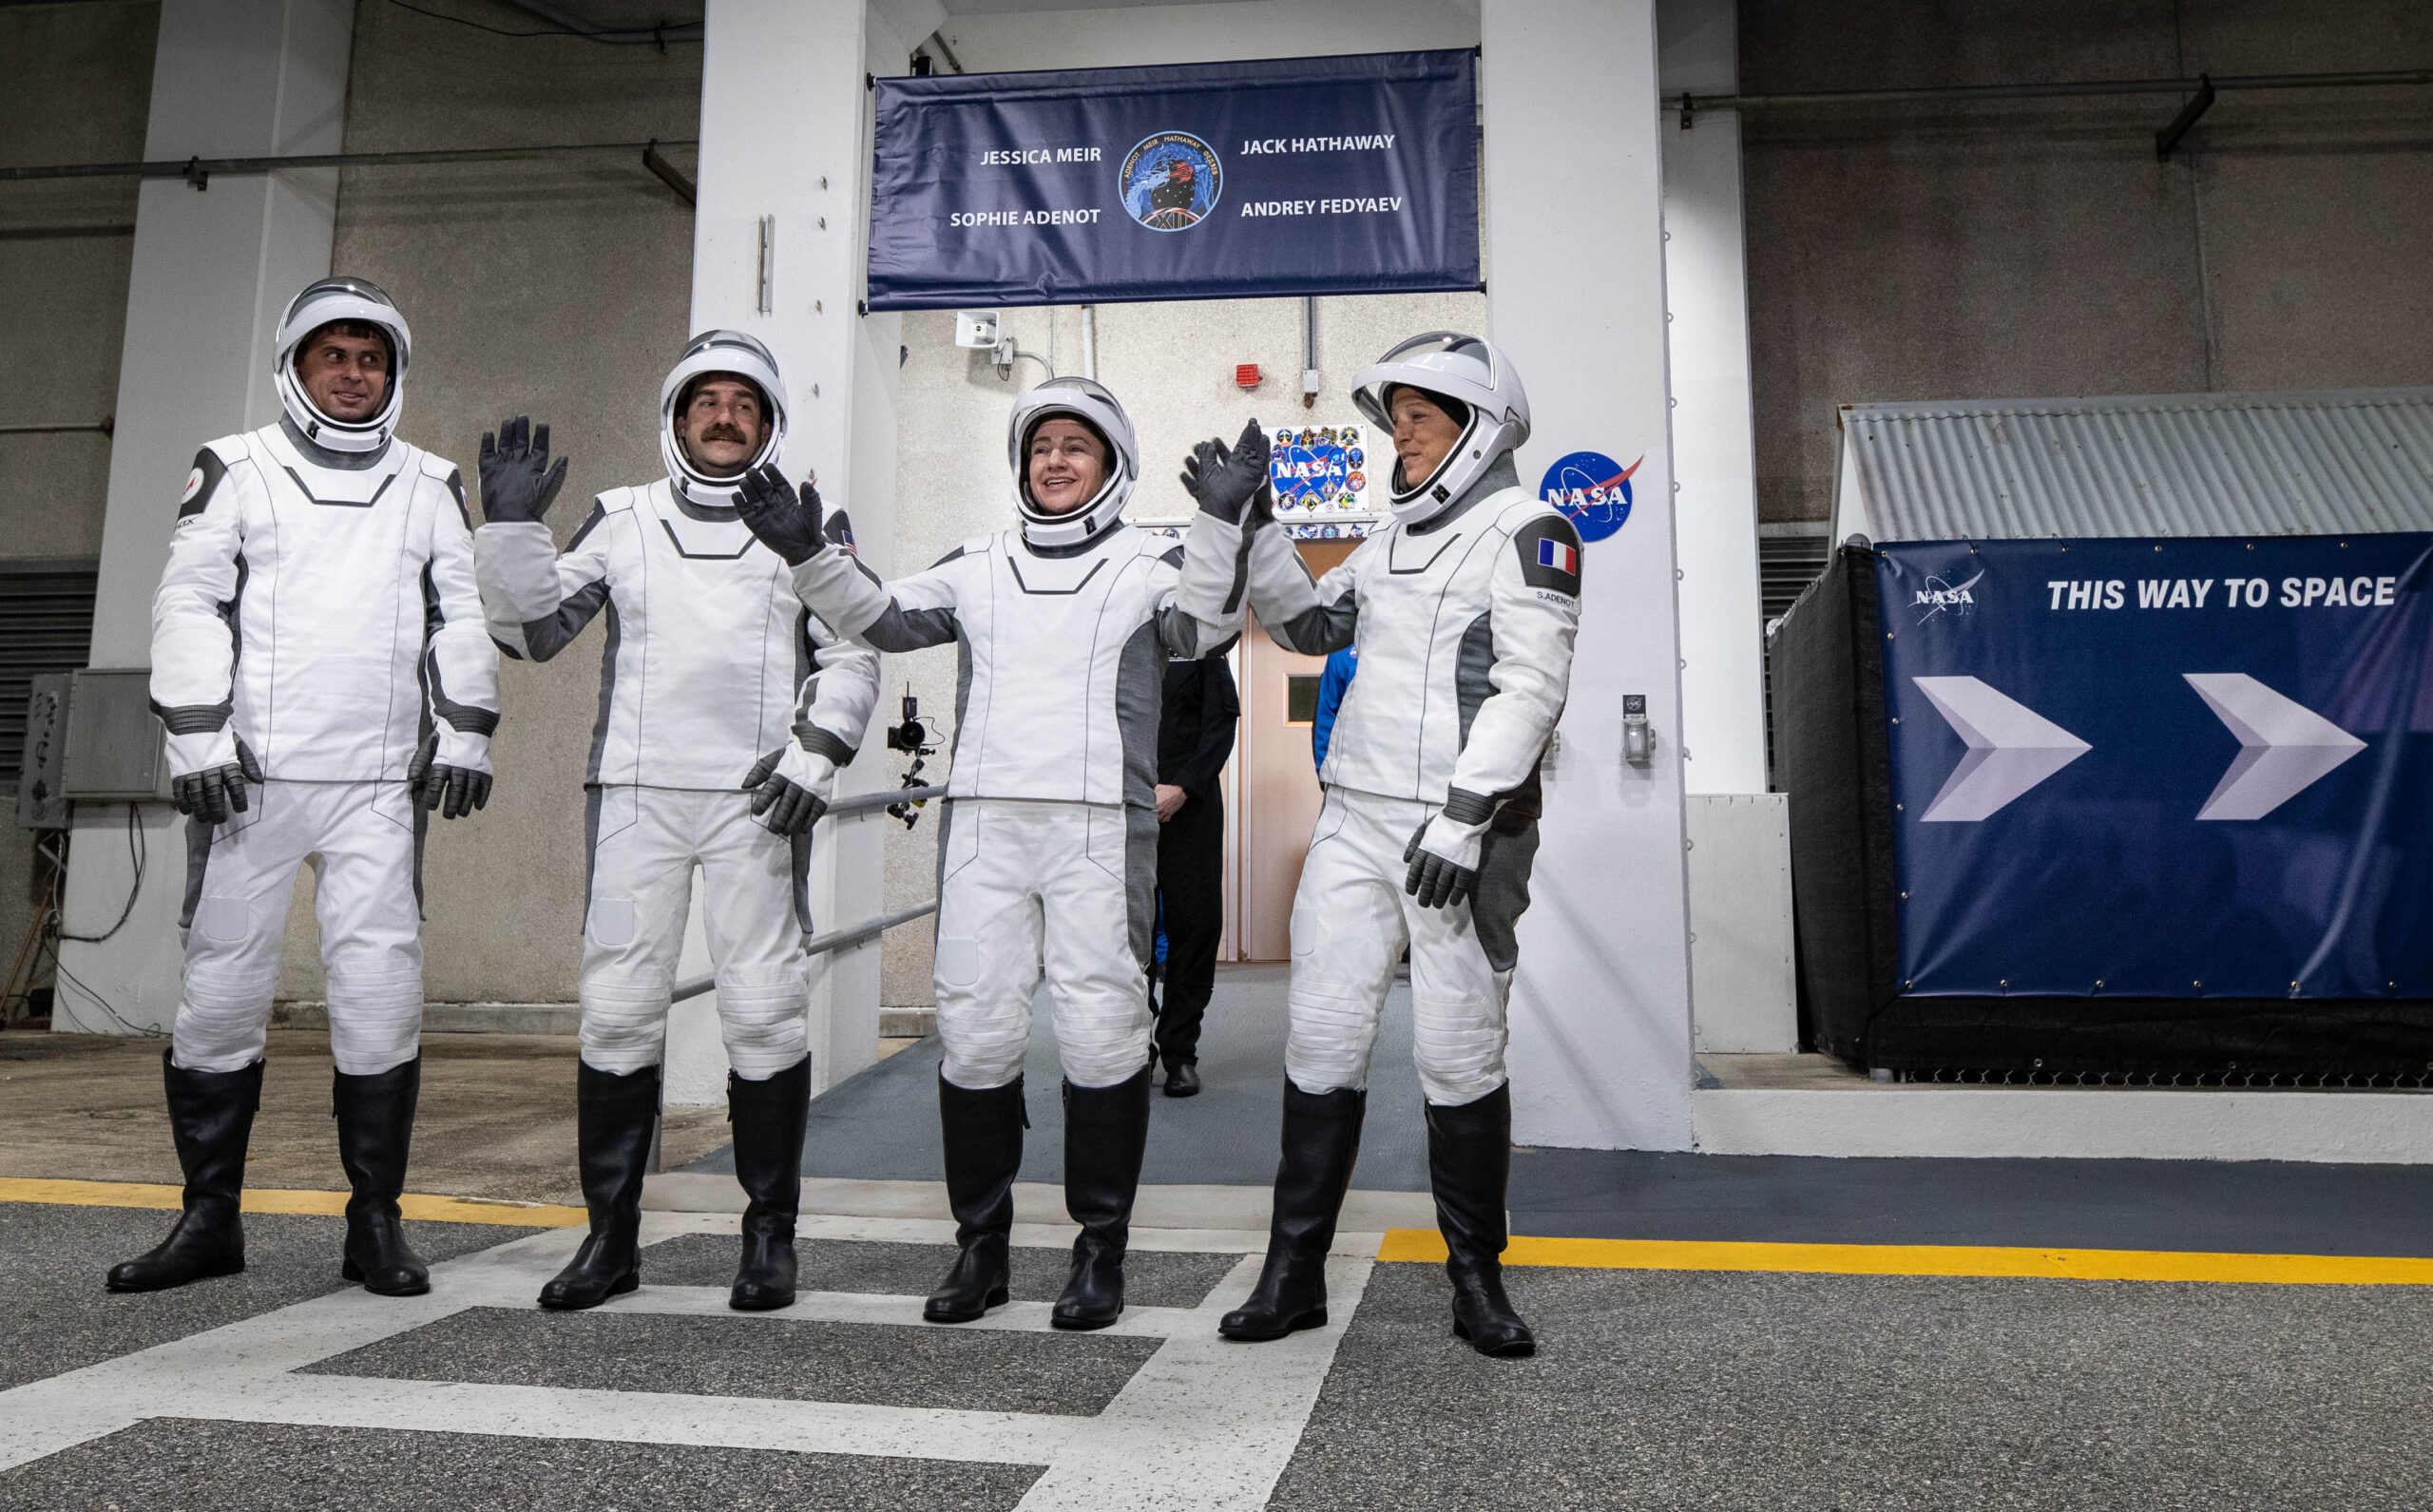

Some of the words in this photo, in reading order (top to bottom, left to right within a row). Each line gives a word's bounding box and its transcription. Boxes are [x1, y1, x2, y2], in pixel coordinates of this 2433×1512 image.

[1240, 139, 1287, 155] JACK
[1292, 134, 1395, 153] HATHAWAY
[980, 149, 1052, 165] JESSICA
[1056, 147, 1102, 163] MEIR
[1124, 152, 1140, 179] ADENOT
[1143, 139, 1159, 150] MEIR
[1164, 136, 1200, 148] HATHAWAY
[1240, 200, 1316, 218] ANDREY
[1320, 197, 1402, 214] FEDYAEV
[950, 211, 1019, 226] SOPHIE
[1023, 209, 1102, 225] ADENOT
[1276, 461, 1344, 478] NASA
[1547, 486, 1628, 507] NASA
[1537, 590, 1575, 607] S.ADENOT
[1915, 590, 1975, 604] NASA
[2047, 580, 2125, 609] THIS
[2137, 579, 2214, 609] WAY
[2224, 578, 2270, 607] TO
[2280, 576, 2396, 607] SPACE
